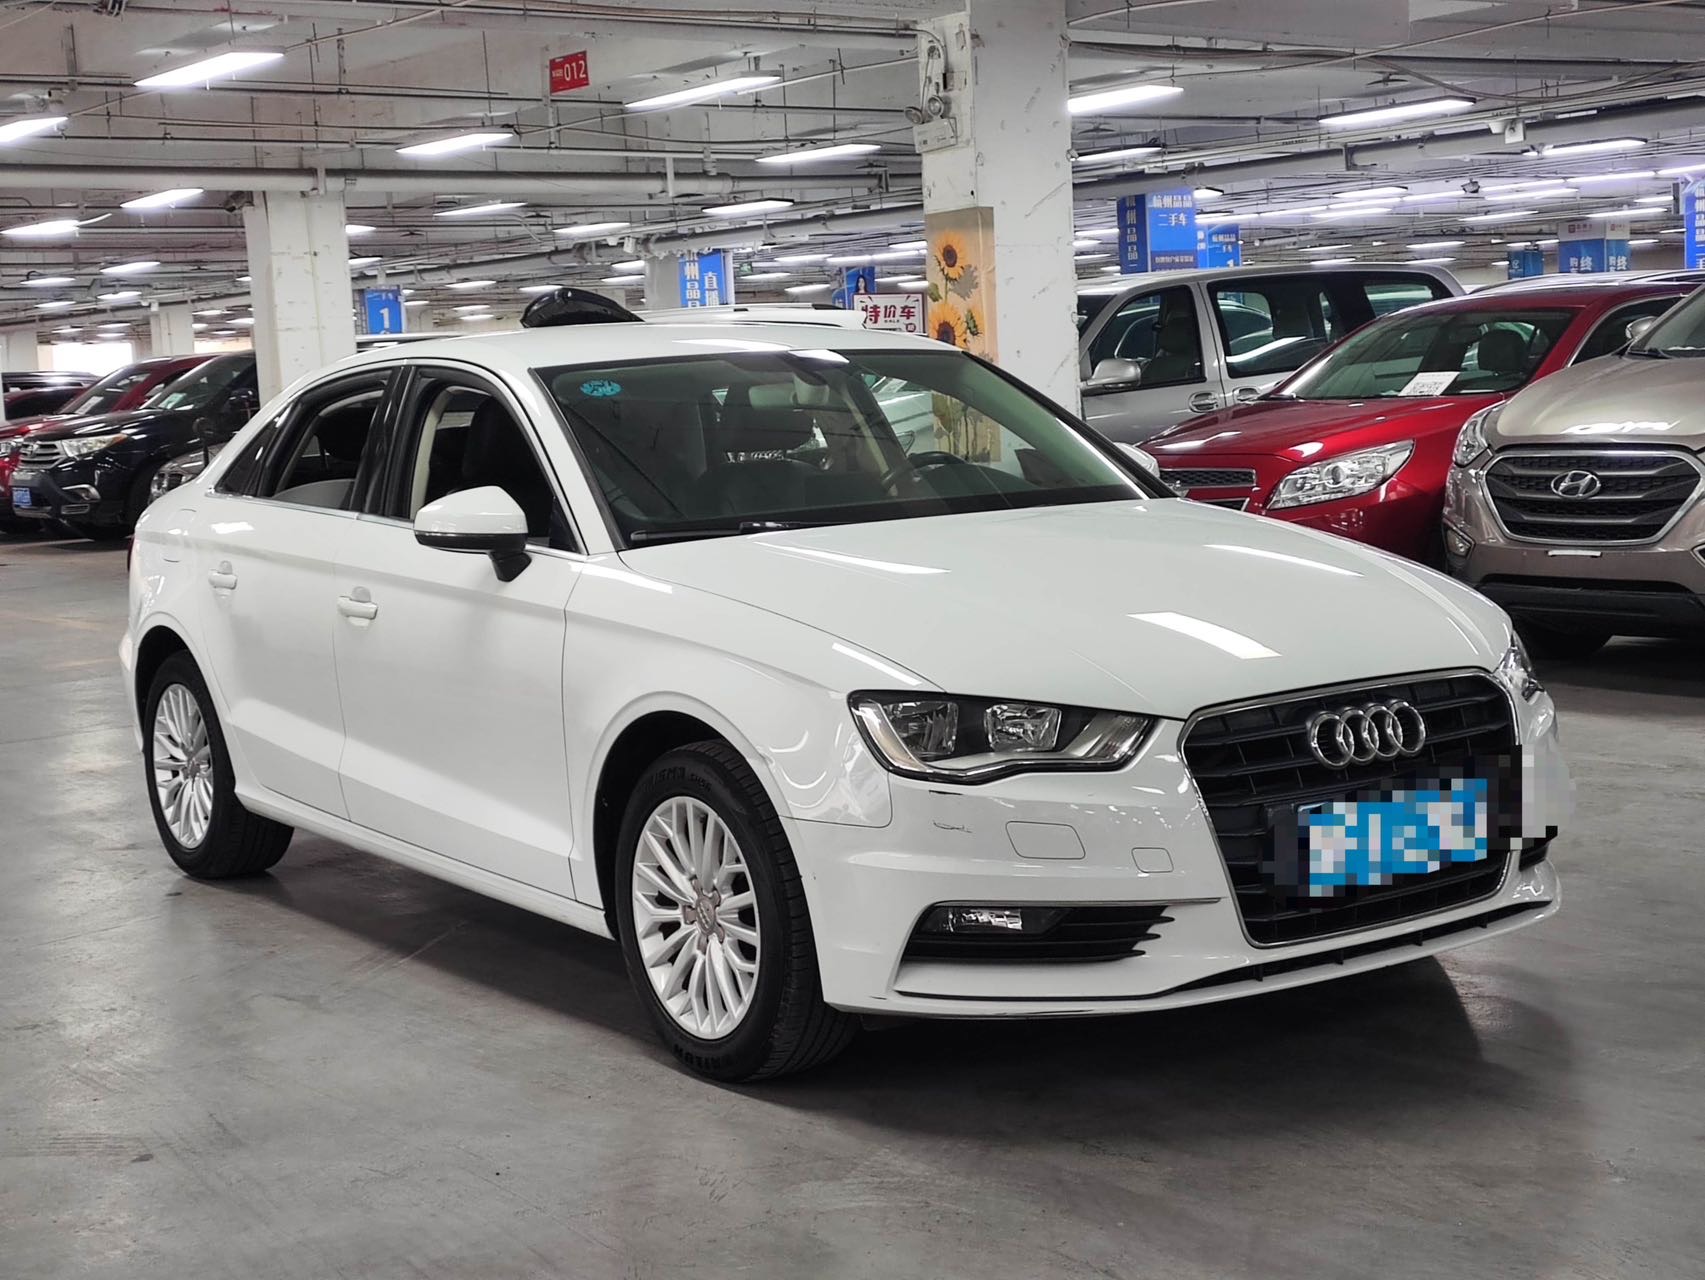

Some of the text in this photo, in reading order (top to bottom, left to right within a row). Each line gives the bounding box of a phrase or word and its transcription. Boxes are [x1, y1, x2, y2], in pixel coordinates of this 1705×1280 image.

[564, 60, 586, 81] 012
[1158, 213, 1187, 227] 二手车
[379, 307, 390, 329] 1
[861, 304, 916, 324] 特价车
